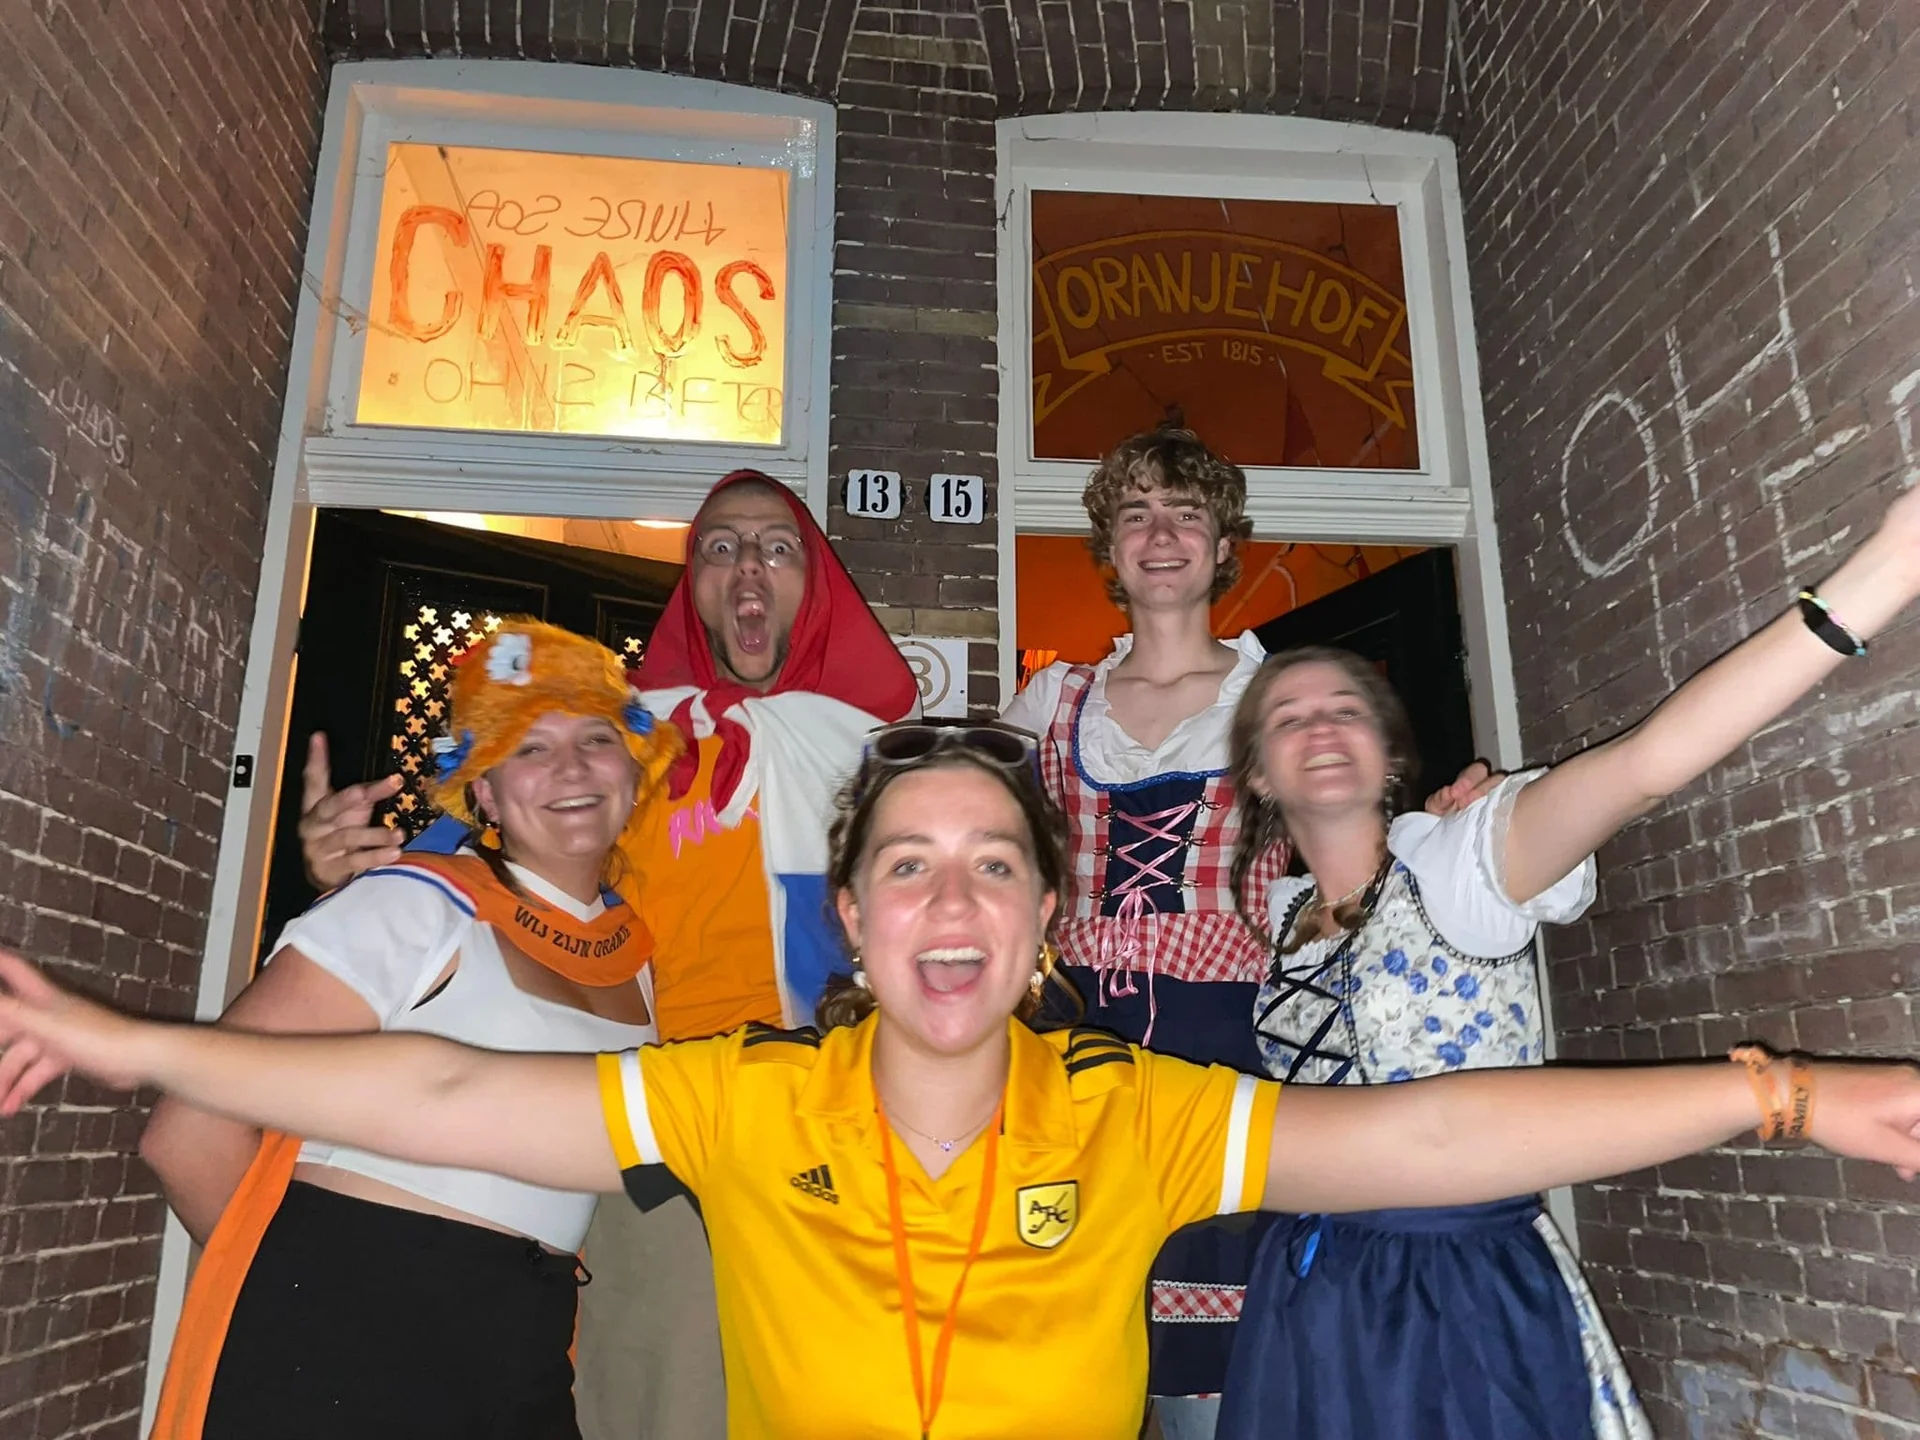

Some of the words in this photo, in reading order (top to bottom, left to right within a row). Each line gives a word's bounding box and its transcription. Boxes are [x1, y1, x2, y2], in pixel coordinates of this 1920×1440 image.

[388, 204, 776, 369] CHAOS
[1056, 251, 1391, 349] ORANJEHOF
[1161, 341, 1206, 363] EST
[1222, 339, 1264, 366] 1815
[57, 374, 128, 465] CHAOS
[857, 473, 890, 513] 13
[940, 477, 973, 518] 15
[513, 905, 549, 939] WIJ
[552, 929, 591, 958] ZIJN
[789, 1175, 840, 1206] adidas
